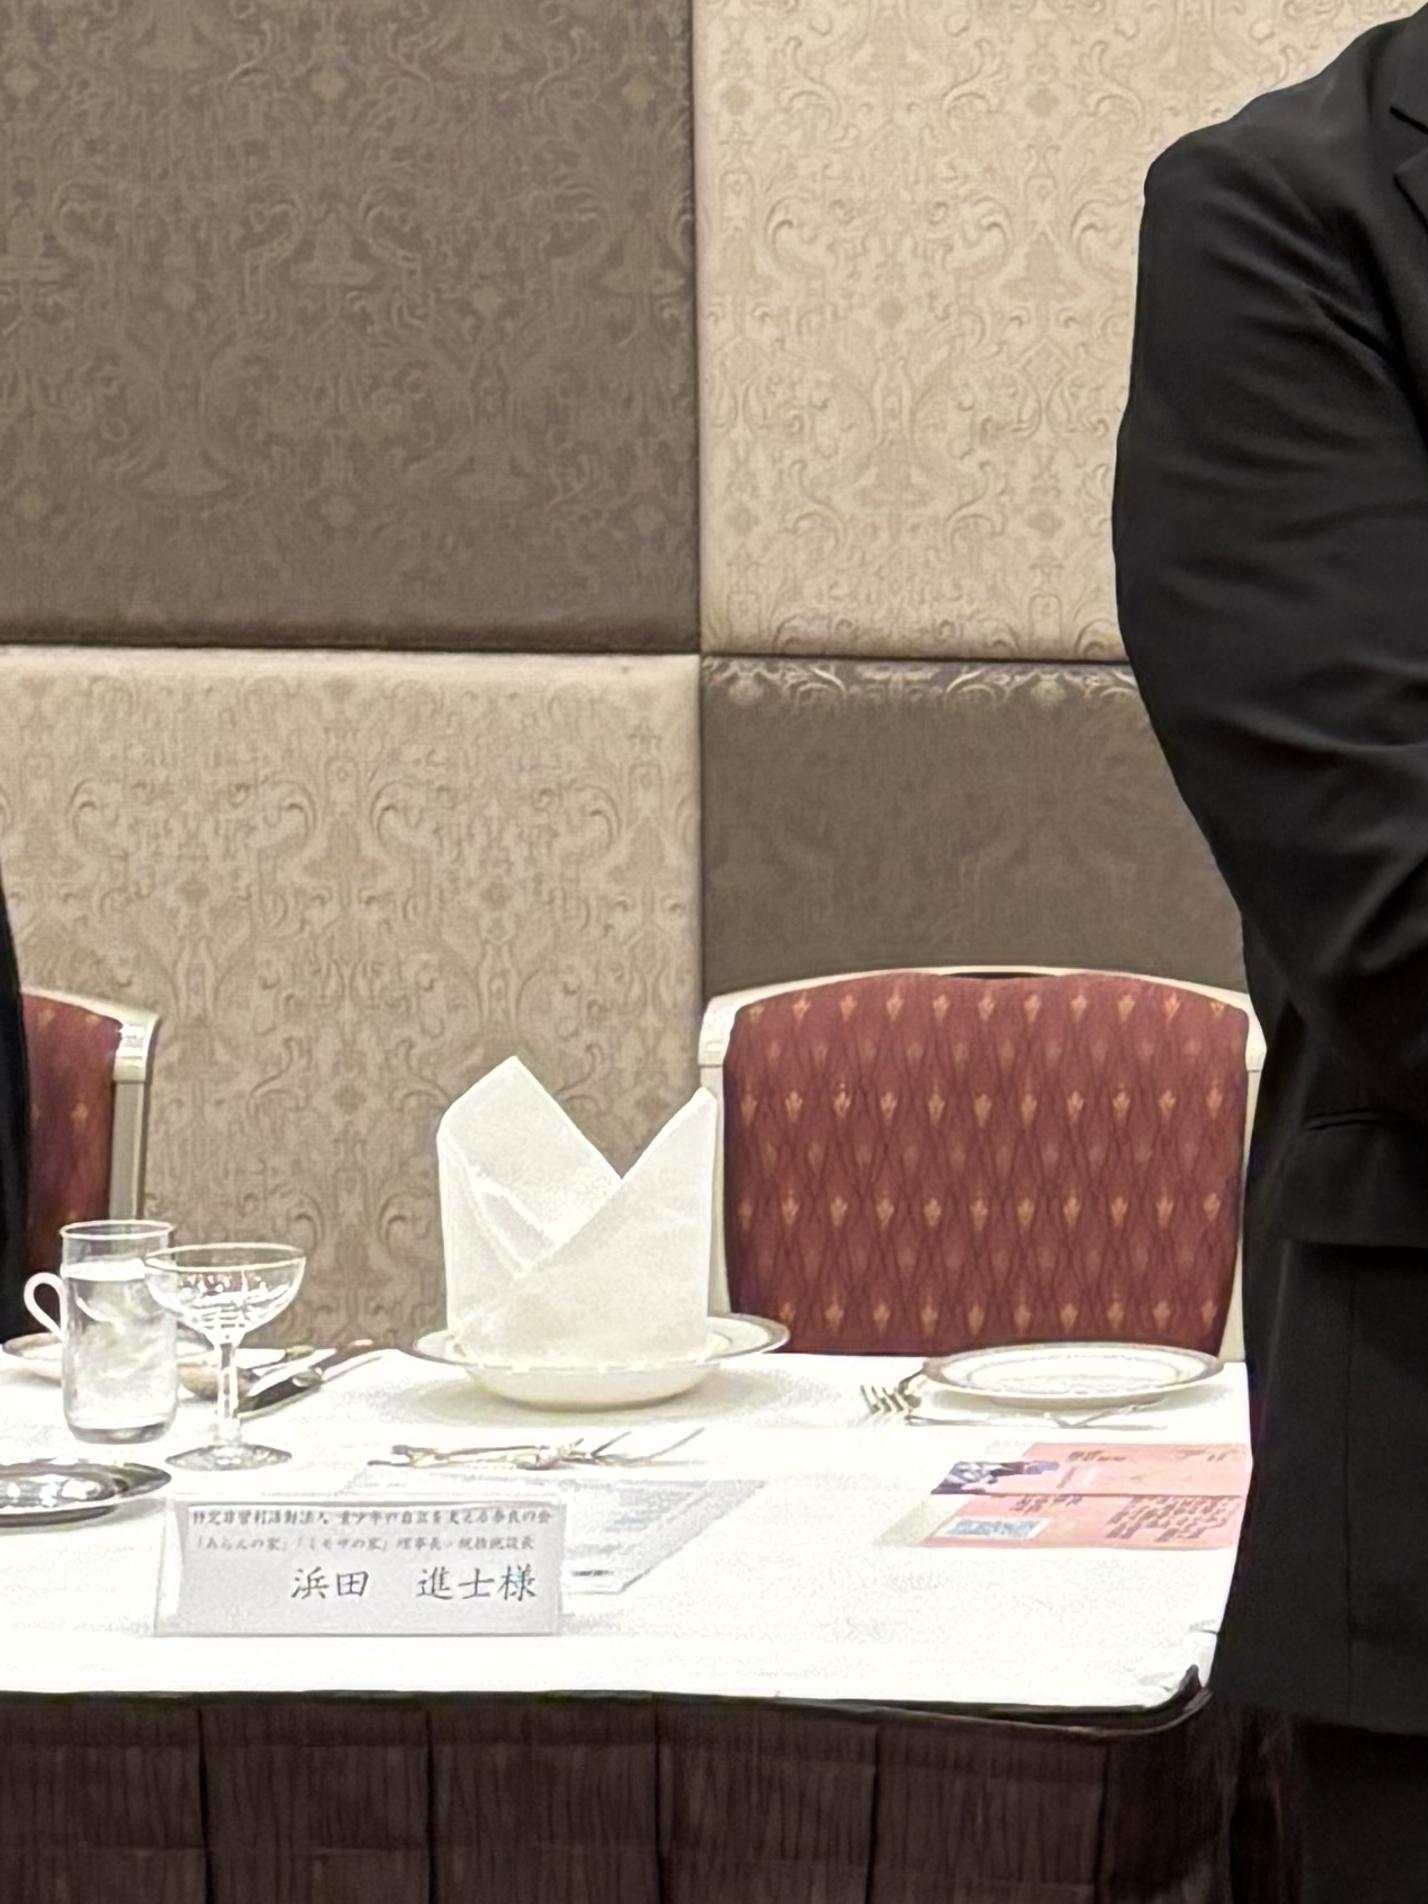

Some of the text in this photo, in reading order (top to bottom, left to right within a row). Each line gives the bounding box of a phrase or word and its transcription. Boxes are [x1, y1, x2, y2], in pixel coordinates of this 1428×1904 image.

[290, 1562, 537, 1602] 浜田 進士様
